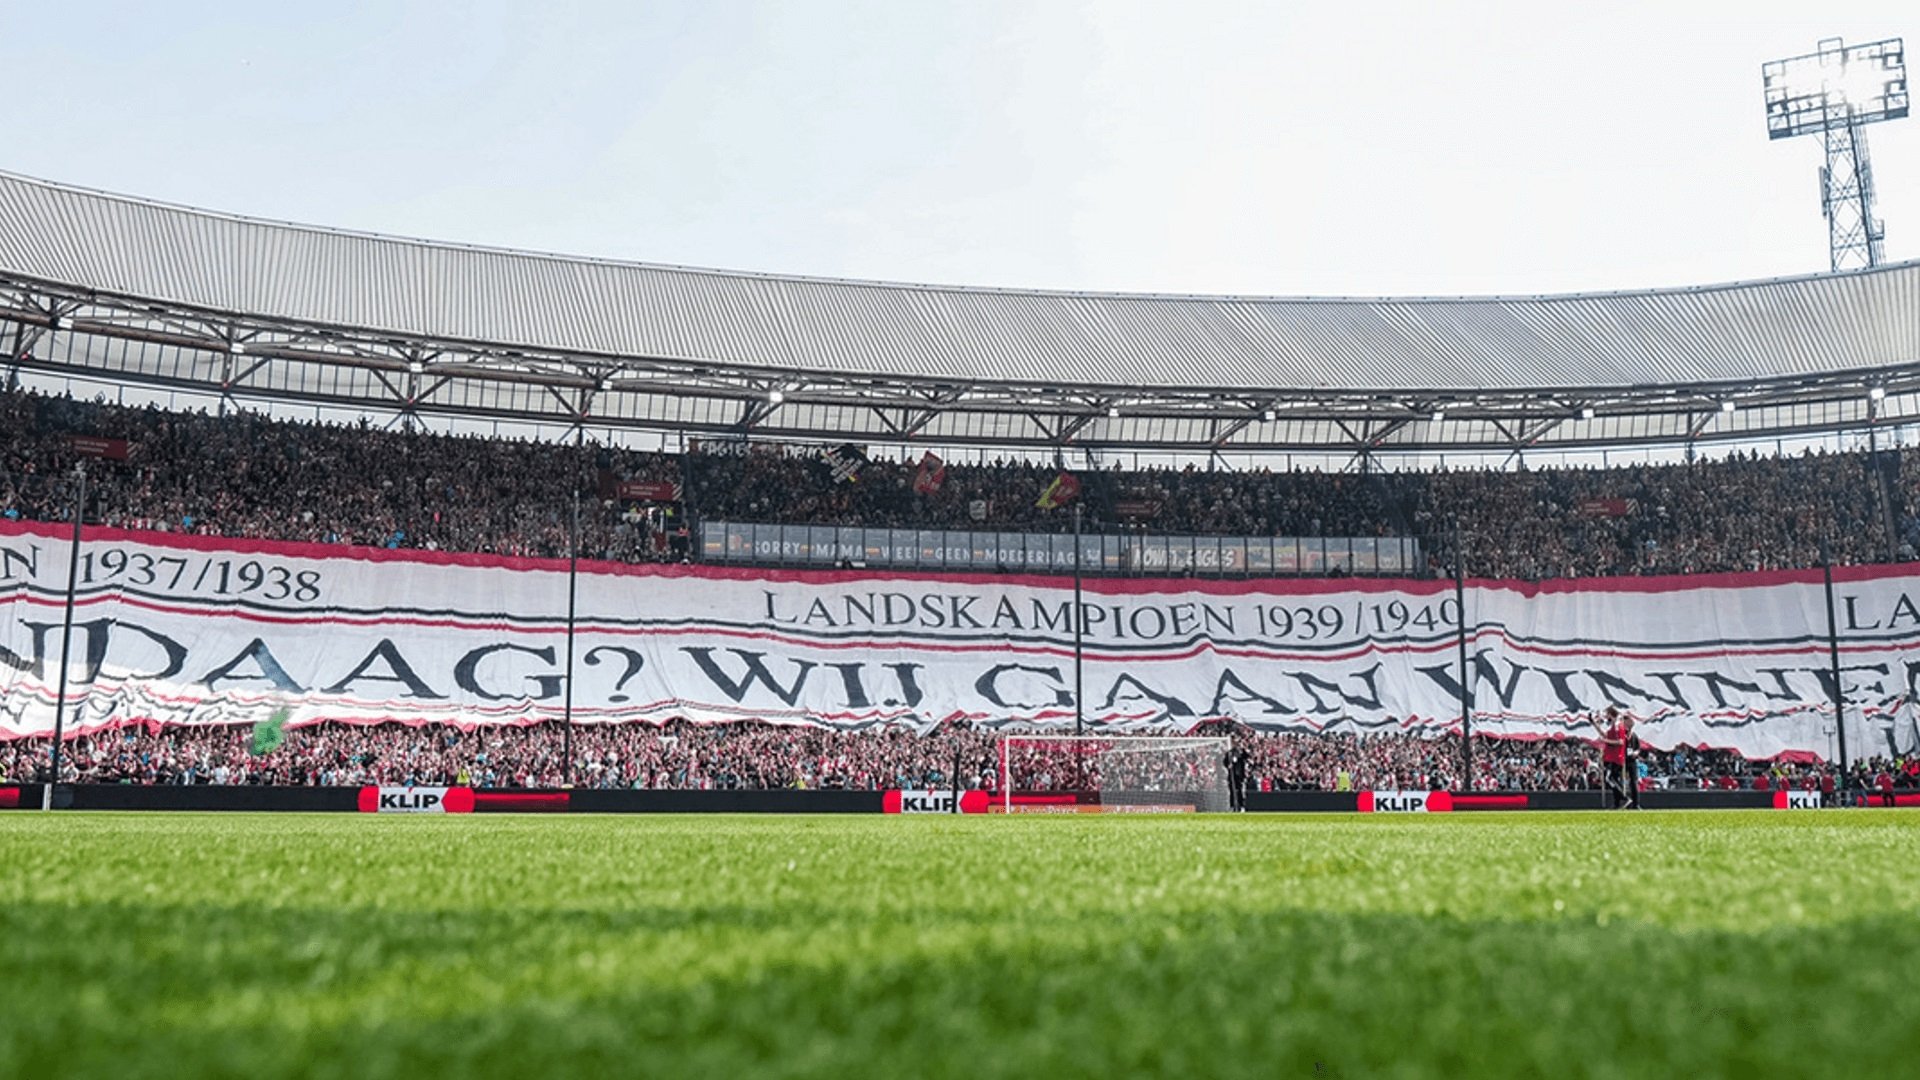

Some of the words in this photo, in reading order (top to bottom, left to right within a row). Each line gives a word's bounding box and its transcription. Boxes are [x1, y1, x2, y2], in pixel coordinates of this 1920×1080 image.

[754, 539, 800, 556] SORRY
[79, 548, 321, 602] 1937/1938
[763, 589, 1236, 639] LANDSKAMPIOEN
[1254, 597, 1463, 640] 1939/1940
[1843, 593, 1920, 630] LA
[974, 661, 1384, 716] GAAN
[1414, 647, 1920, 712] WINNE
[380, 794, 439, 808] KLIP
[903, 797, 955, 811] KLIP
[1375, 798, 1423, 811] KLIP
[1789, 798, 1818, 809] KLI
